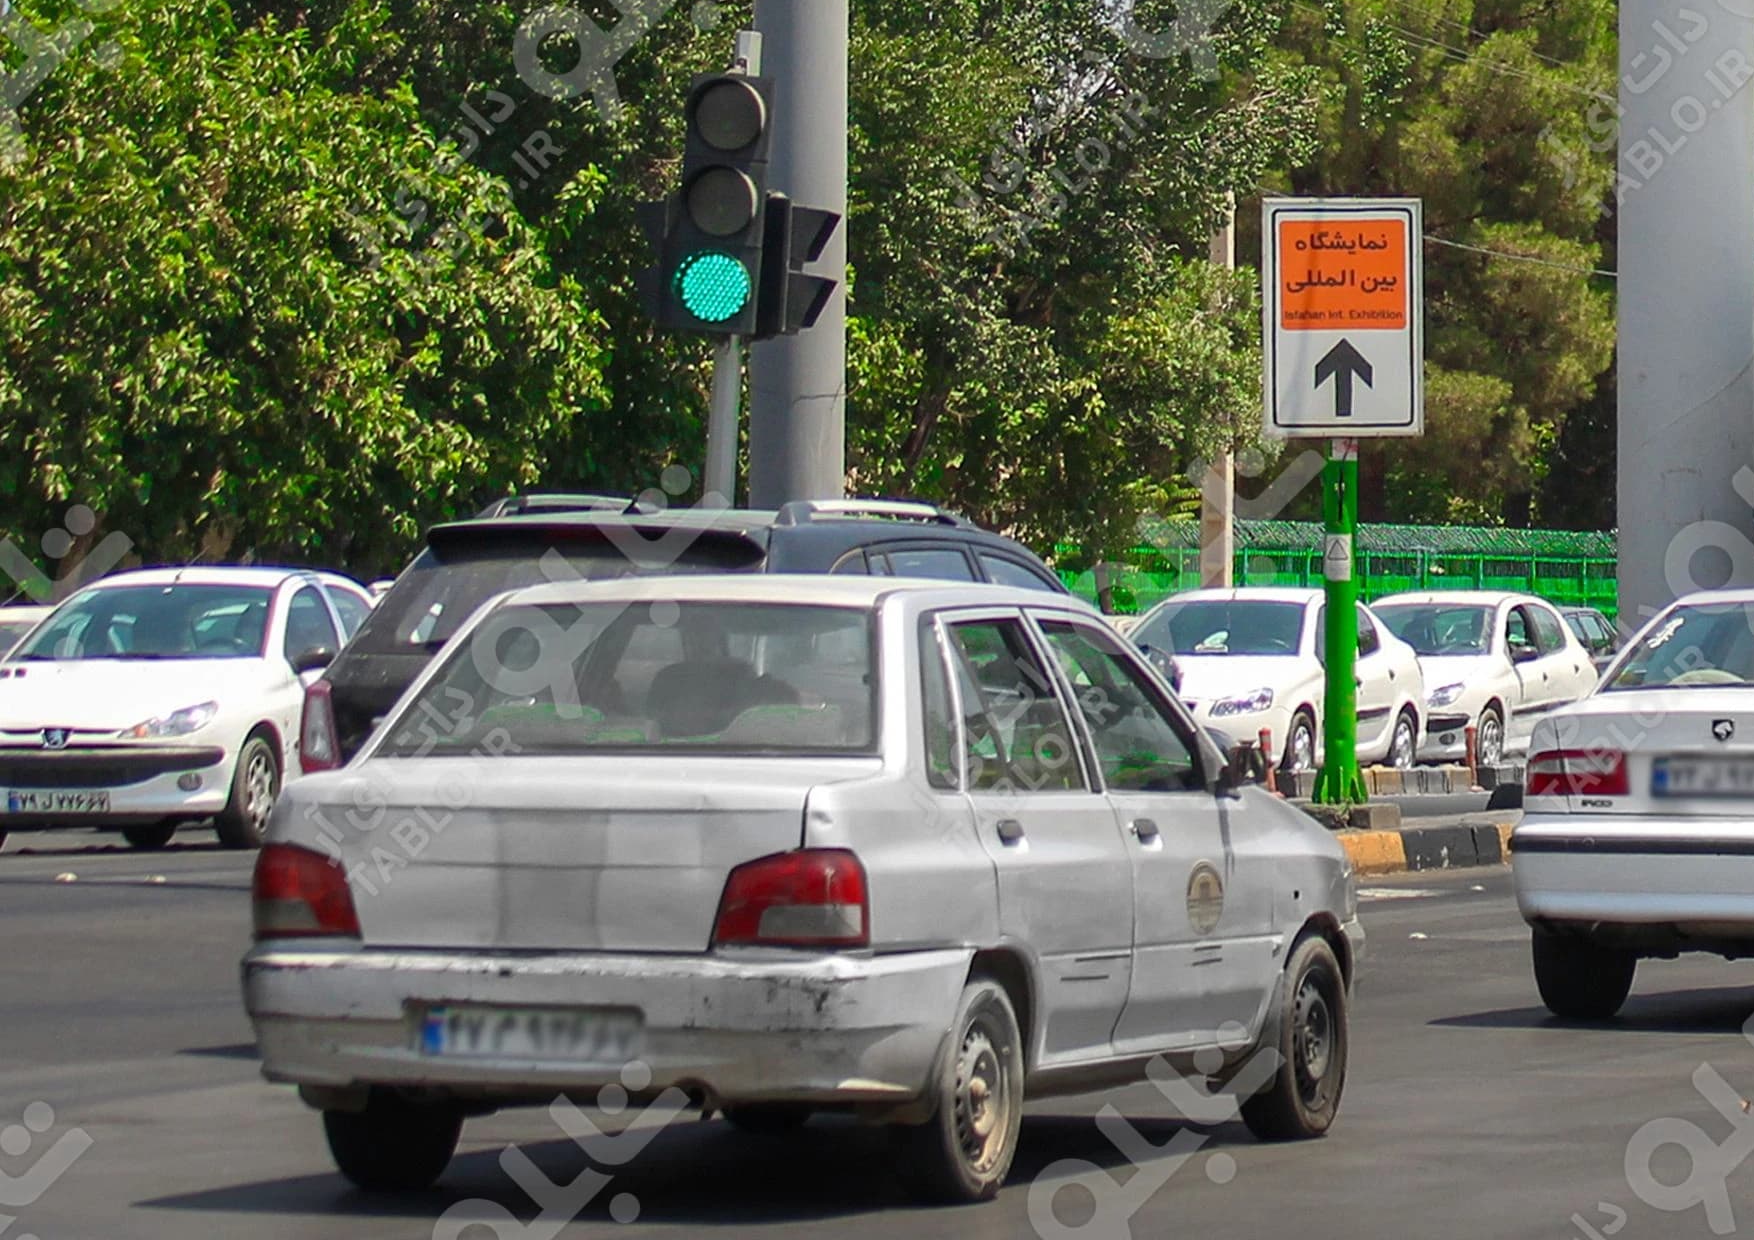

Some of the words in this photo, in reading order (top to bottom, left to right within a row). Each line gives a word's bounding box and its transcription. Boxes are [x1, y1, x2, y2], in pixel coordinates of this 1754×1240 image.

[1295, 231, 1388, 255] نمایشگاه
[1286, 268, 1355, 293] المللی
[1361, 275, 1398, 293] بین
